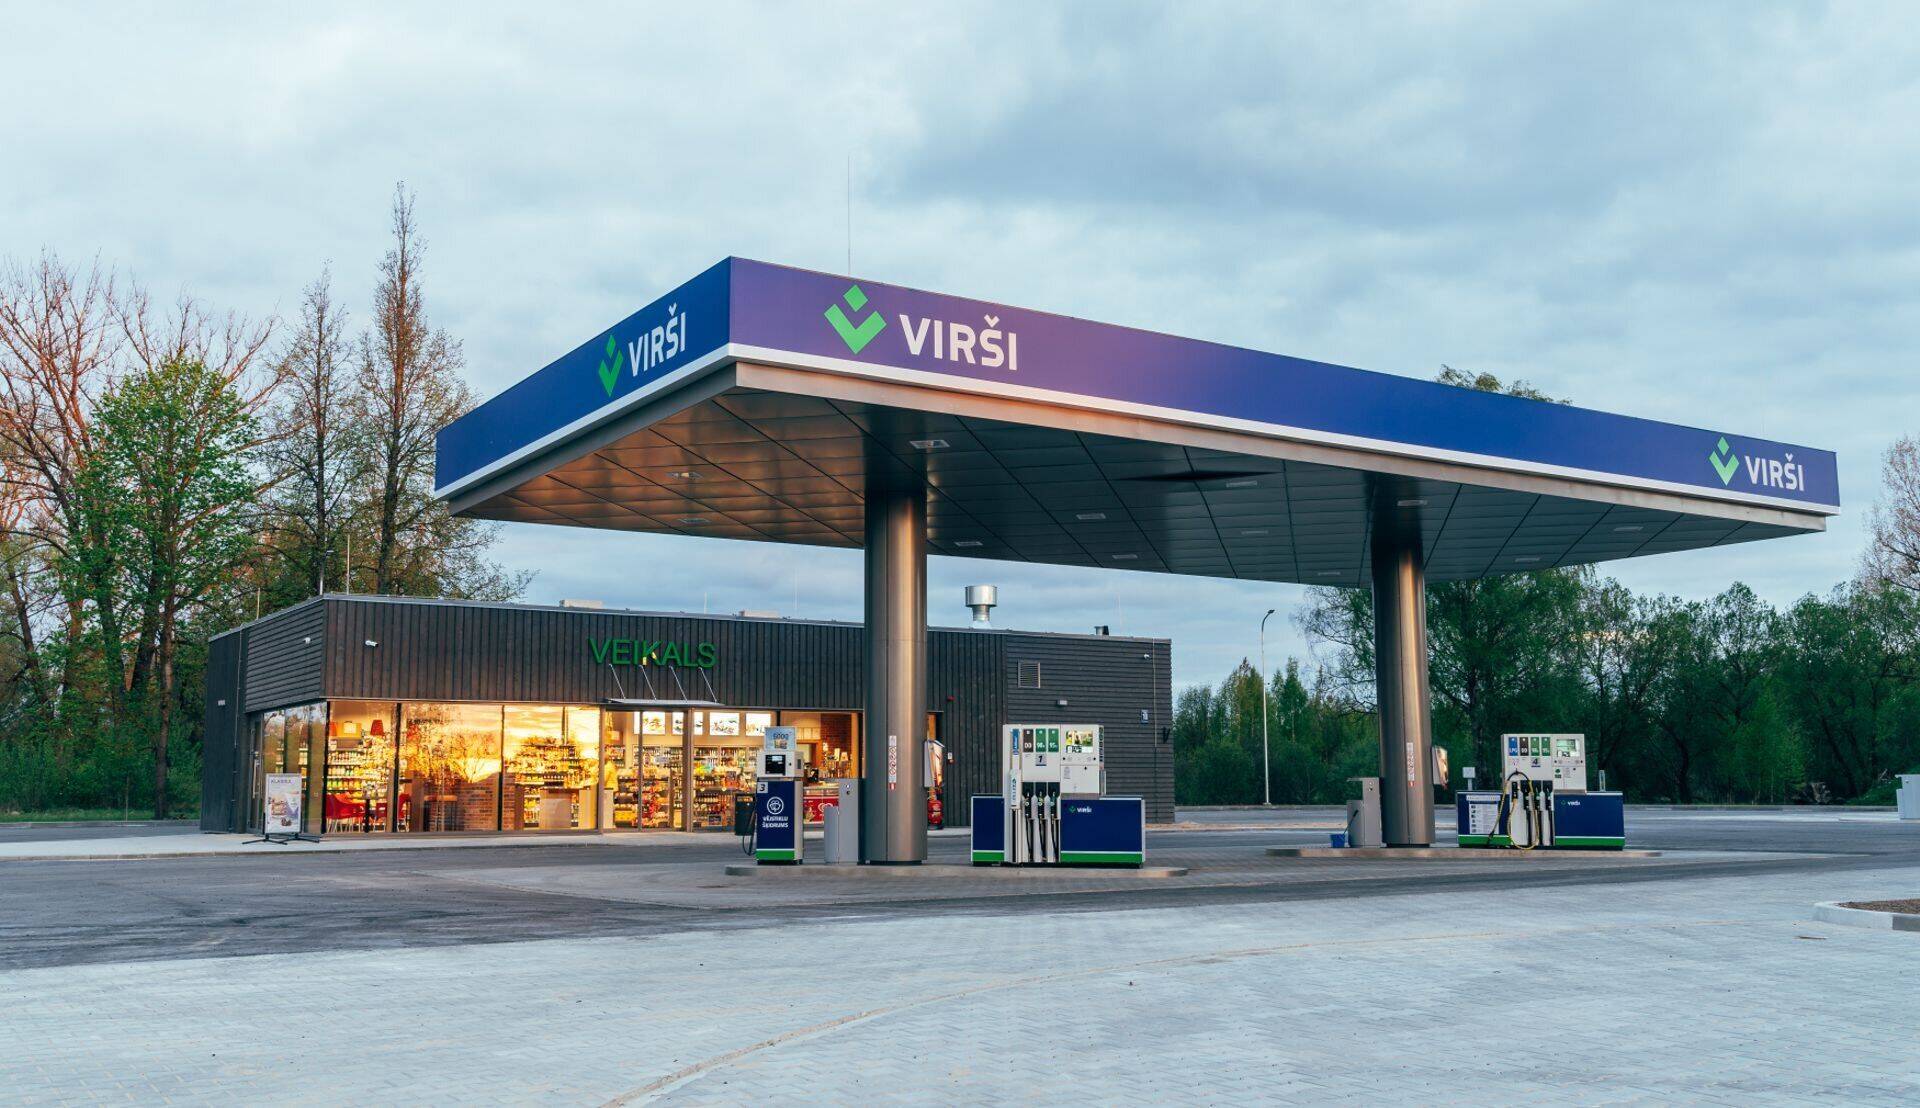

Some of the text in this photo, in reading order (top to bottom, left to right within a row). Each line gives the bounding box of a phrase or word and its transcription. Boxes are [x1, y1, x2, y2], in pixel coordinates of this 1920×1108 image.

[628, 303, 687, 377] VIRŠI
[899, 314, 1018, 371] VIRŠI
[1744, 453, 1805, 492] VIRŠI
[588, 637, 718, 669] VEIKALS
[1038, 755, 1043, 763] 1
[759, 783, 766, 792] 3
